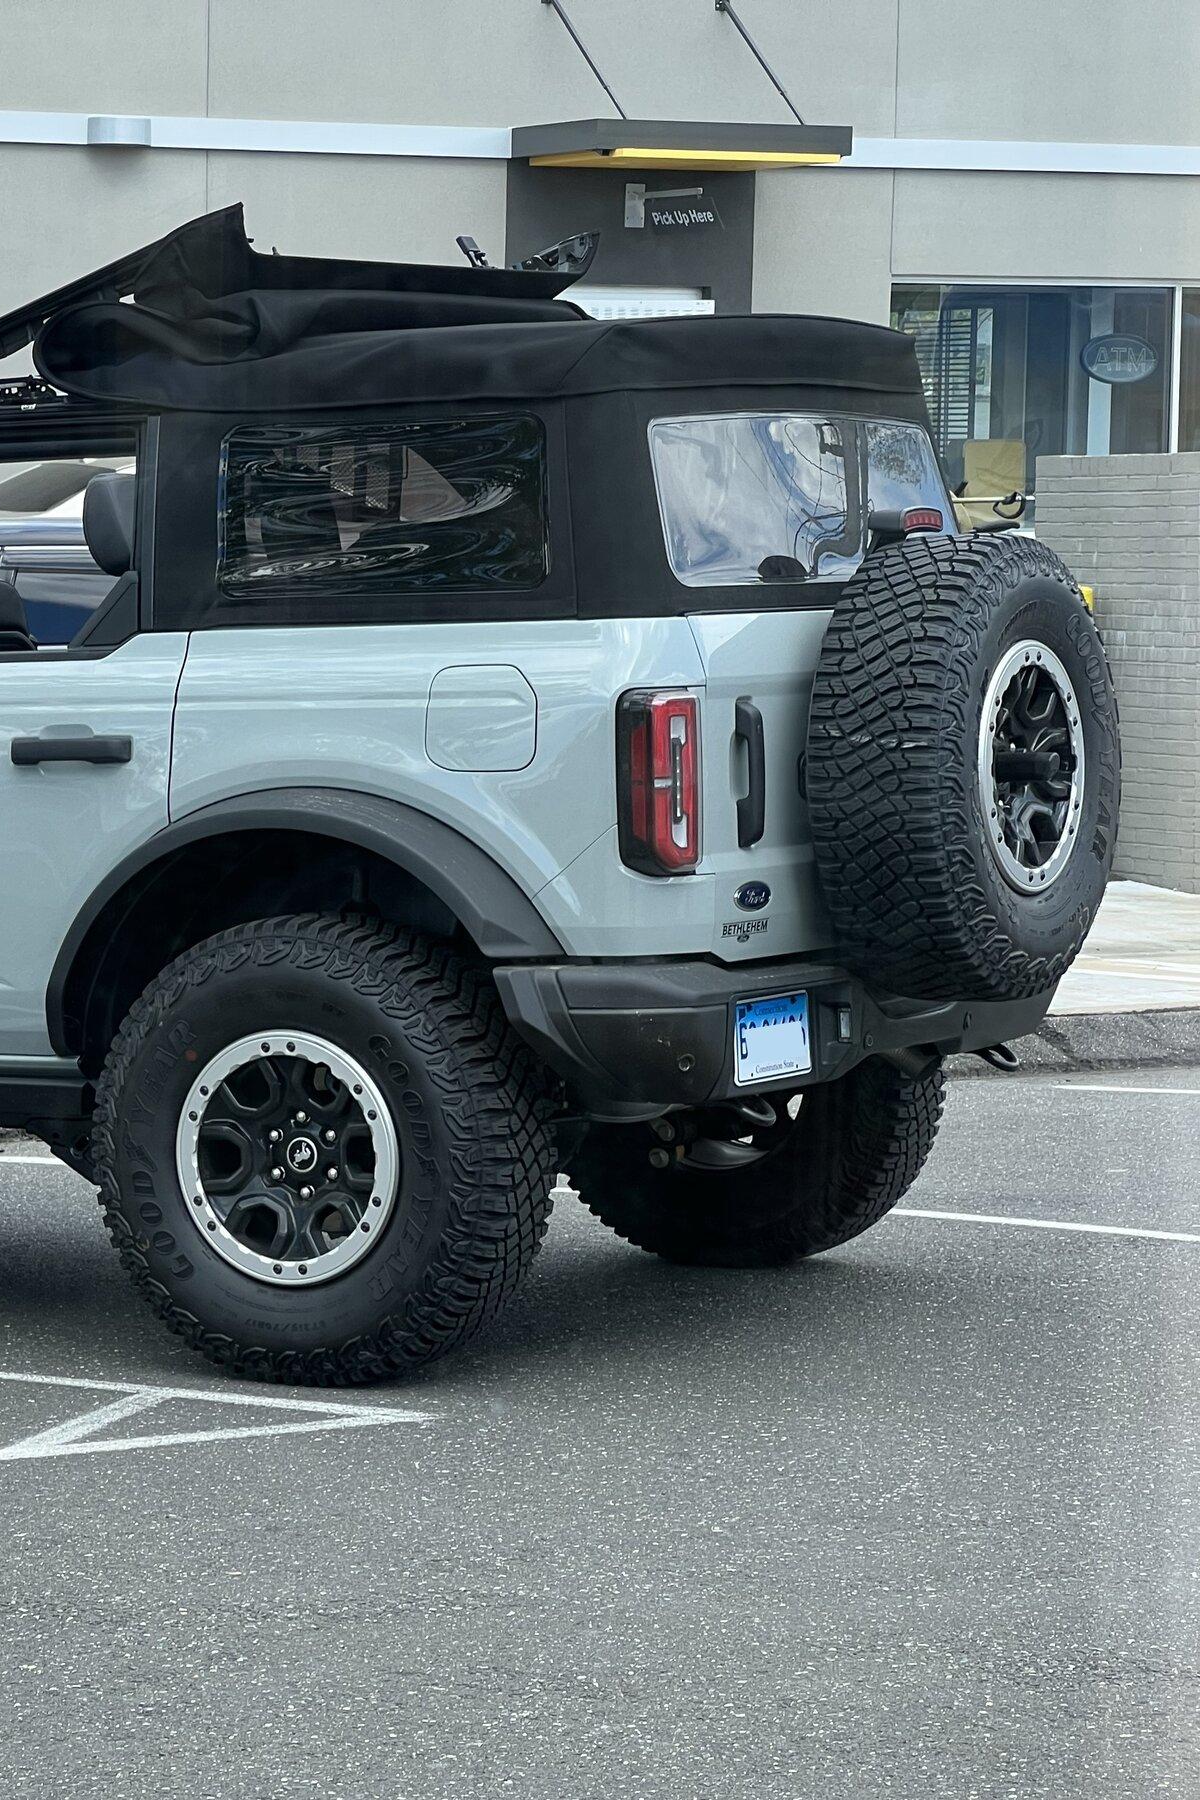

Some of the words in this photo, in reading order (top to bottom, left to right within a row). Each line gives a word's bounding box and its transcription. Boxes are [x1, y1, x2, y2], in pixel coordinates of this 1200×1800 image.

[651, 211, 675, 225] Pick
[674, 210, 689, 226] Up
[689, 209, 714, 223] Here
[1092, 346, 1146, 372] ATM
[722, 920, 768, 936] BETHLEHEM
